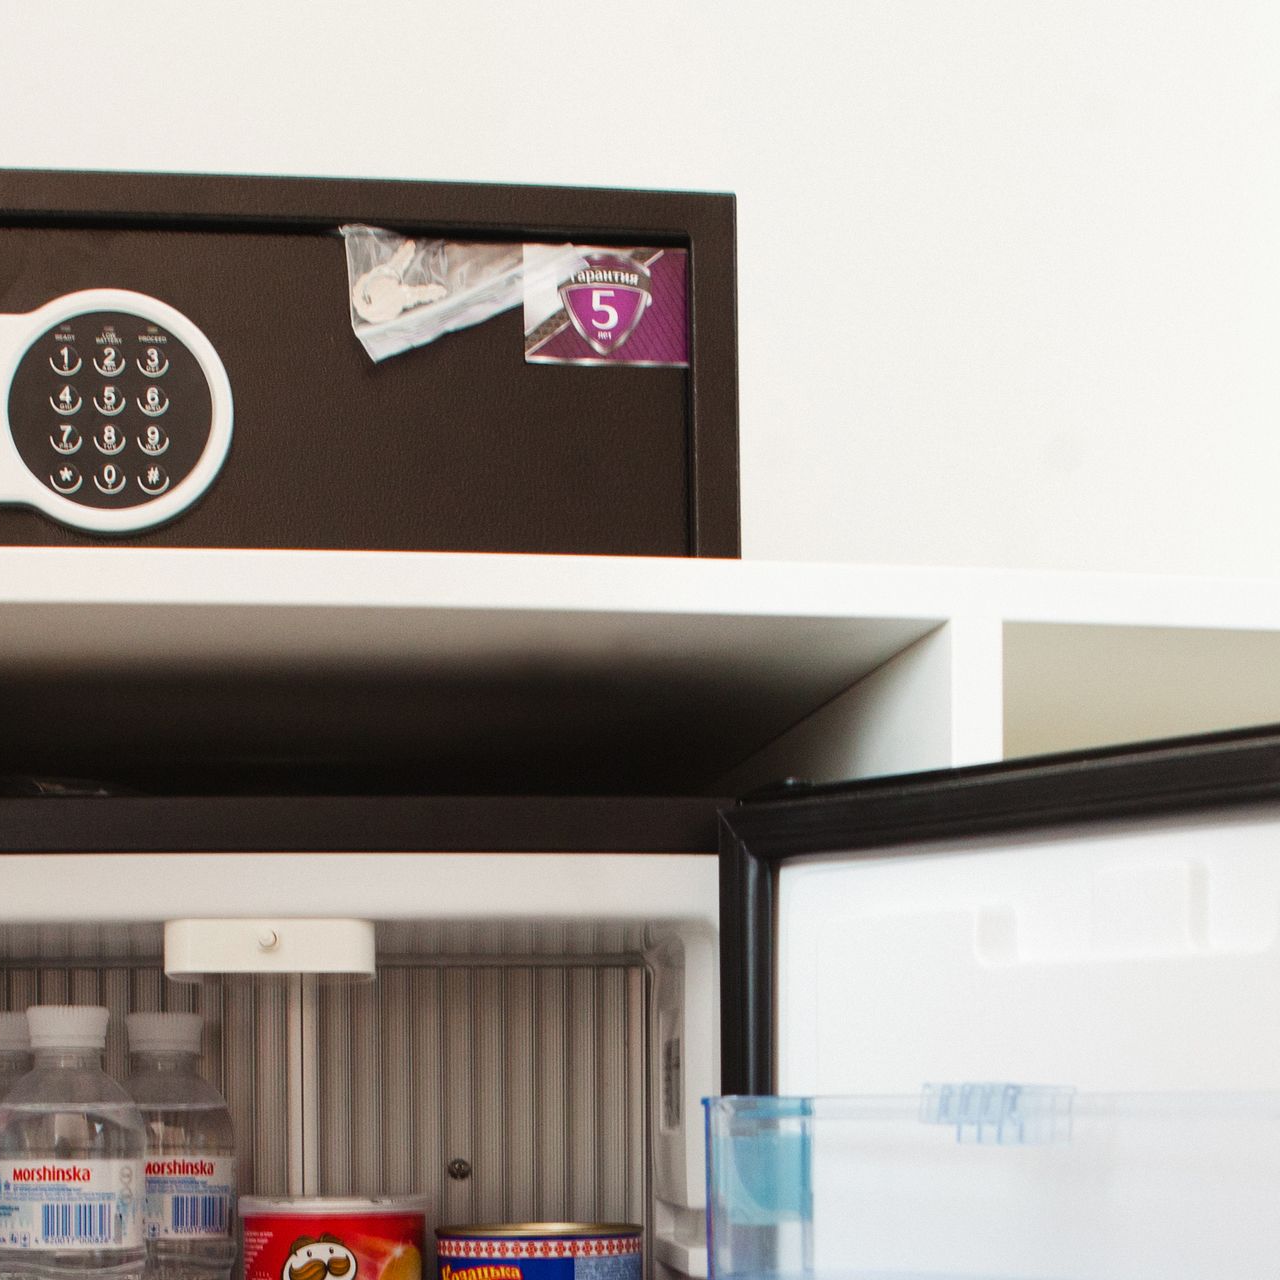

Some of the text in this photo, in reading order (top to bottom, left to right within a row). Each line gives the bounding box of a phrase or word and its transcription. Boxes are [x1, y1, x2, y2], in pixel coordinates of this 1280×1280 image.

[591, 290, 619, 331] 5
[60, 346, 159, 367] 1 2 3
[59, 386, 159, 405] 4 5 6
[60, 425, 159, 445] 7 8 9
[103, 465, 116, 484] 0
[147, 467, 160, 485] #
[13, 1165, 91, 1182] Morshinska
